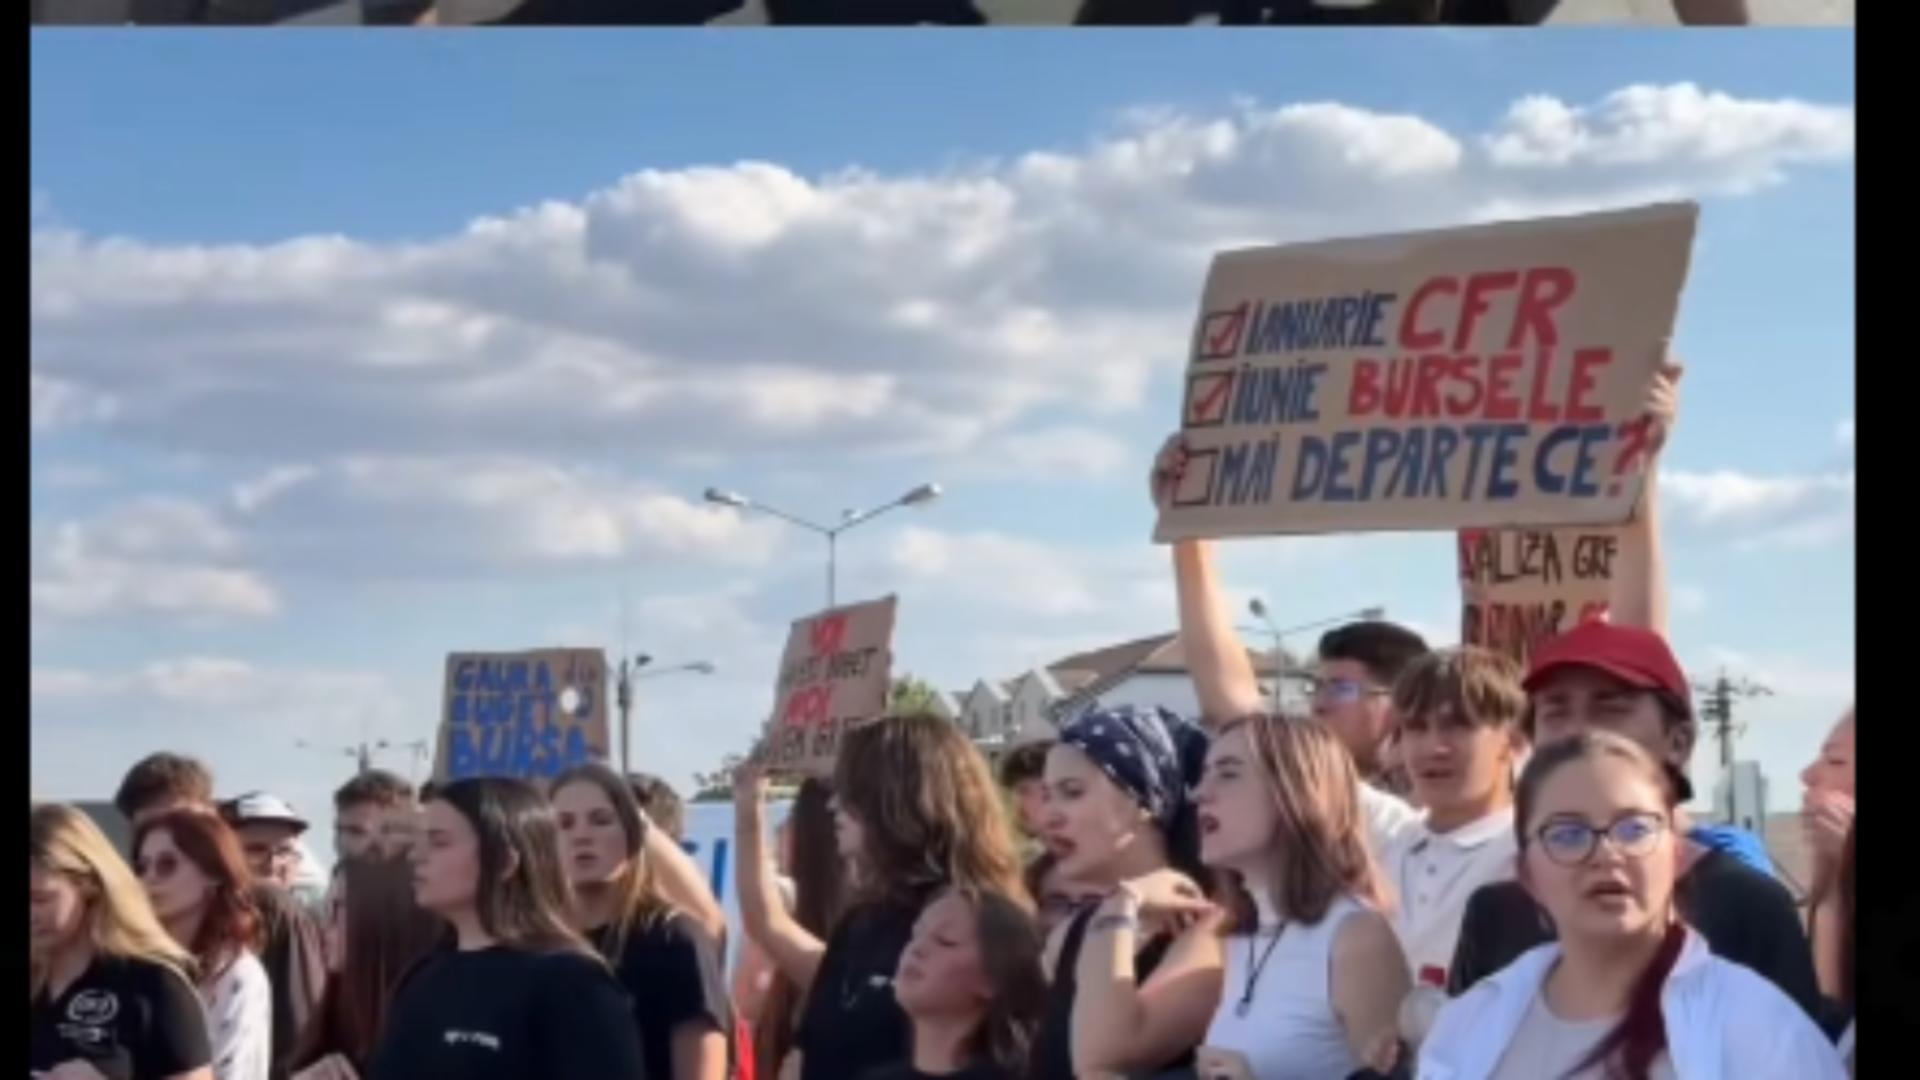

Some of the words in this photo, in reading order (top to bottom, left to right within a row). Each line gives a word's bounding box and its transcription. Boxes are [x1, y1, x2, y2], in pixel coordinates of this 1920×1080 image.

[1245, 289, 1398, 355] IANUARIE
[1396, 267, 1577, 351] CFR
[1231, 359, 1328, 425] IUNIE
[1346, 348, 1613, 422] BURSELE
[1214, 432, 1280, 507] MAI
[1291, 424, 1529, 502] DEPARTE
[450, 724, 586, 779] BURSA
